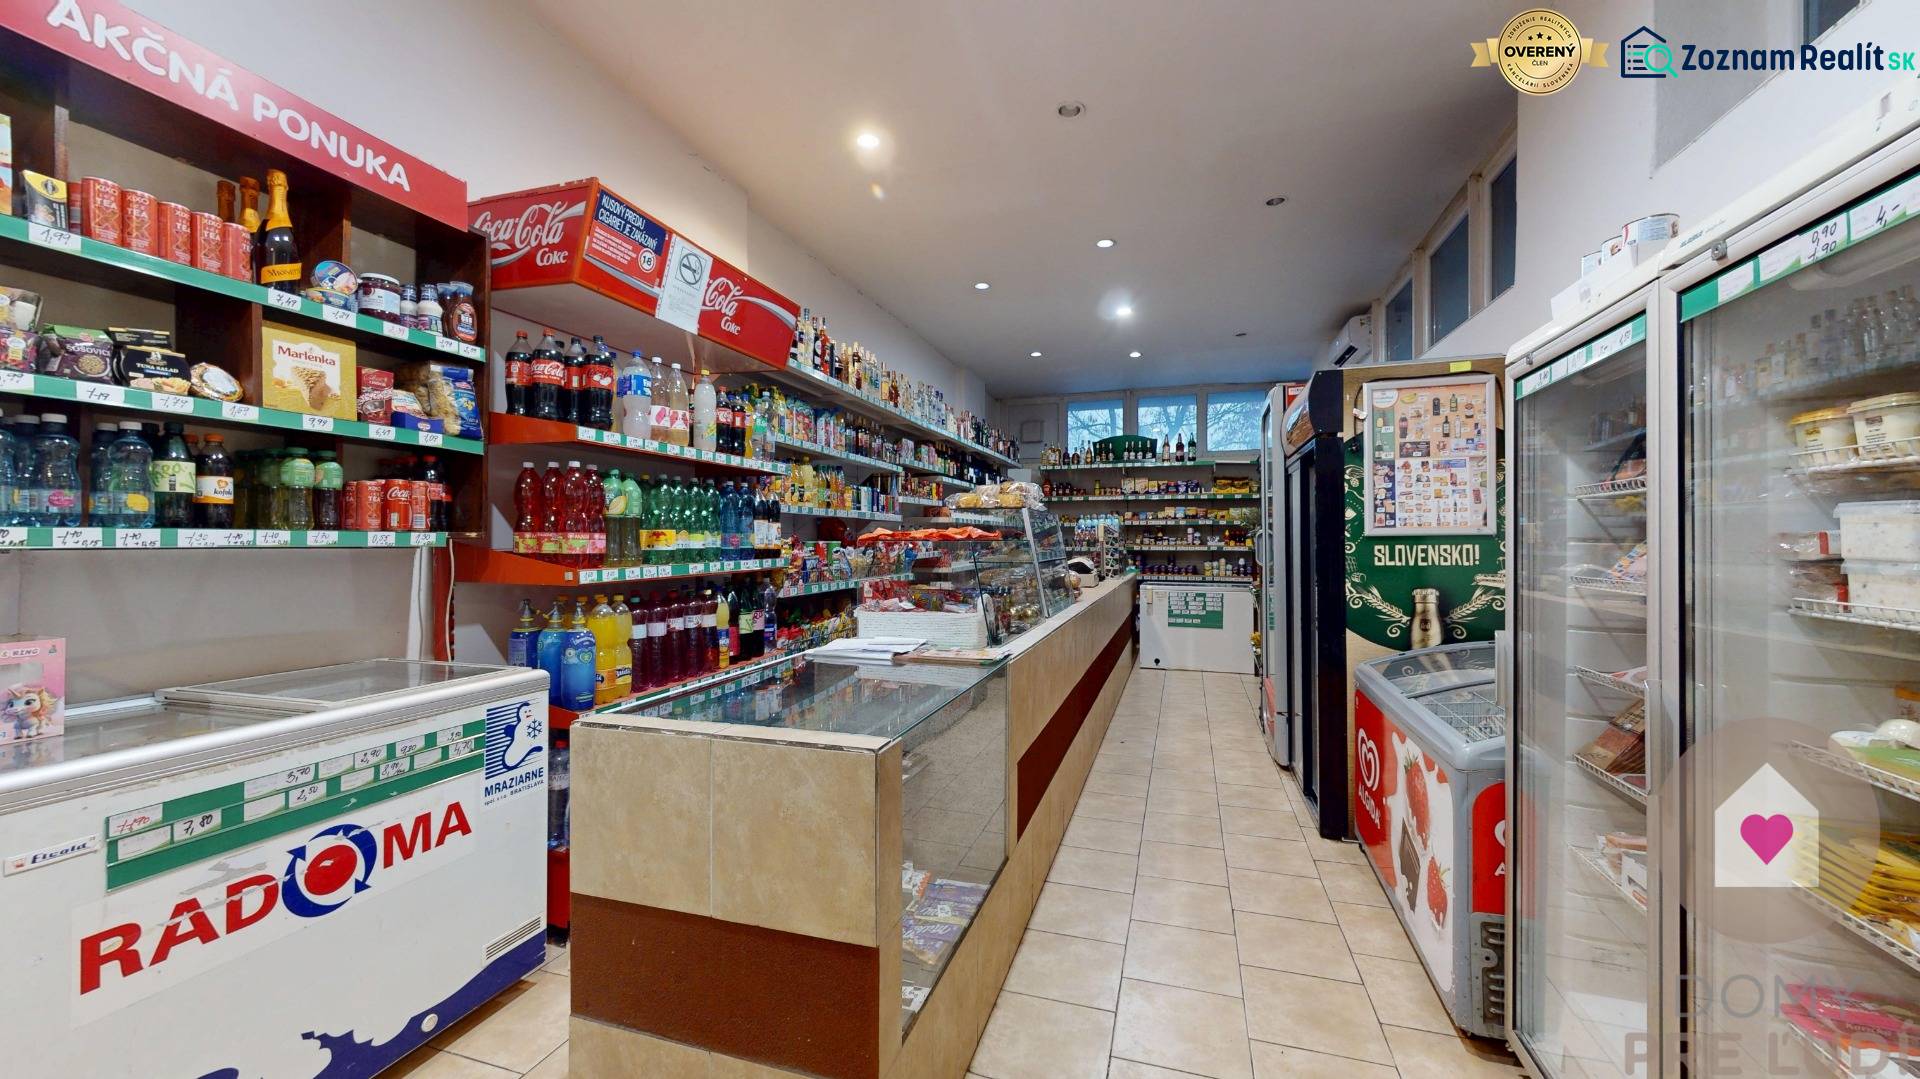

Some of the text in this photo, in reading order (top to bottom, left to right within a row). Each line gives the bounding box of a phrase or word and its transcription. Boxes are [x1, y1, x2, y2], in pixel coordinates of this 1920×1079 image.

[46, 0, 411, 192] AKČNÁ PONUKA
[601, 194, 646, 230] KUSOVÝ PREDAJ
[598, 208, 626, 231] CIGARIET
[623, 224, 631, 236] JE
[630, 229, 659, 251] ZAKÁZANÝ
[1811, 221, 1838, 247] 0,90
[536, 247, 569, 267] Coke
[642, 254, 653, 267] 18
[720, 315, 741, 336] Coke
[277, 344, 337, 367] Marlenka
[1373, 543, 1481, 567] SLOVENSKO!
[484, 766, 544, 798] MRAZIARNE
[510, 779, 544, 796] BRATISLAVA
[1358, 781, 1382, 830] ALGIDA
[79, 800, 473, 996] RADOMA
